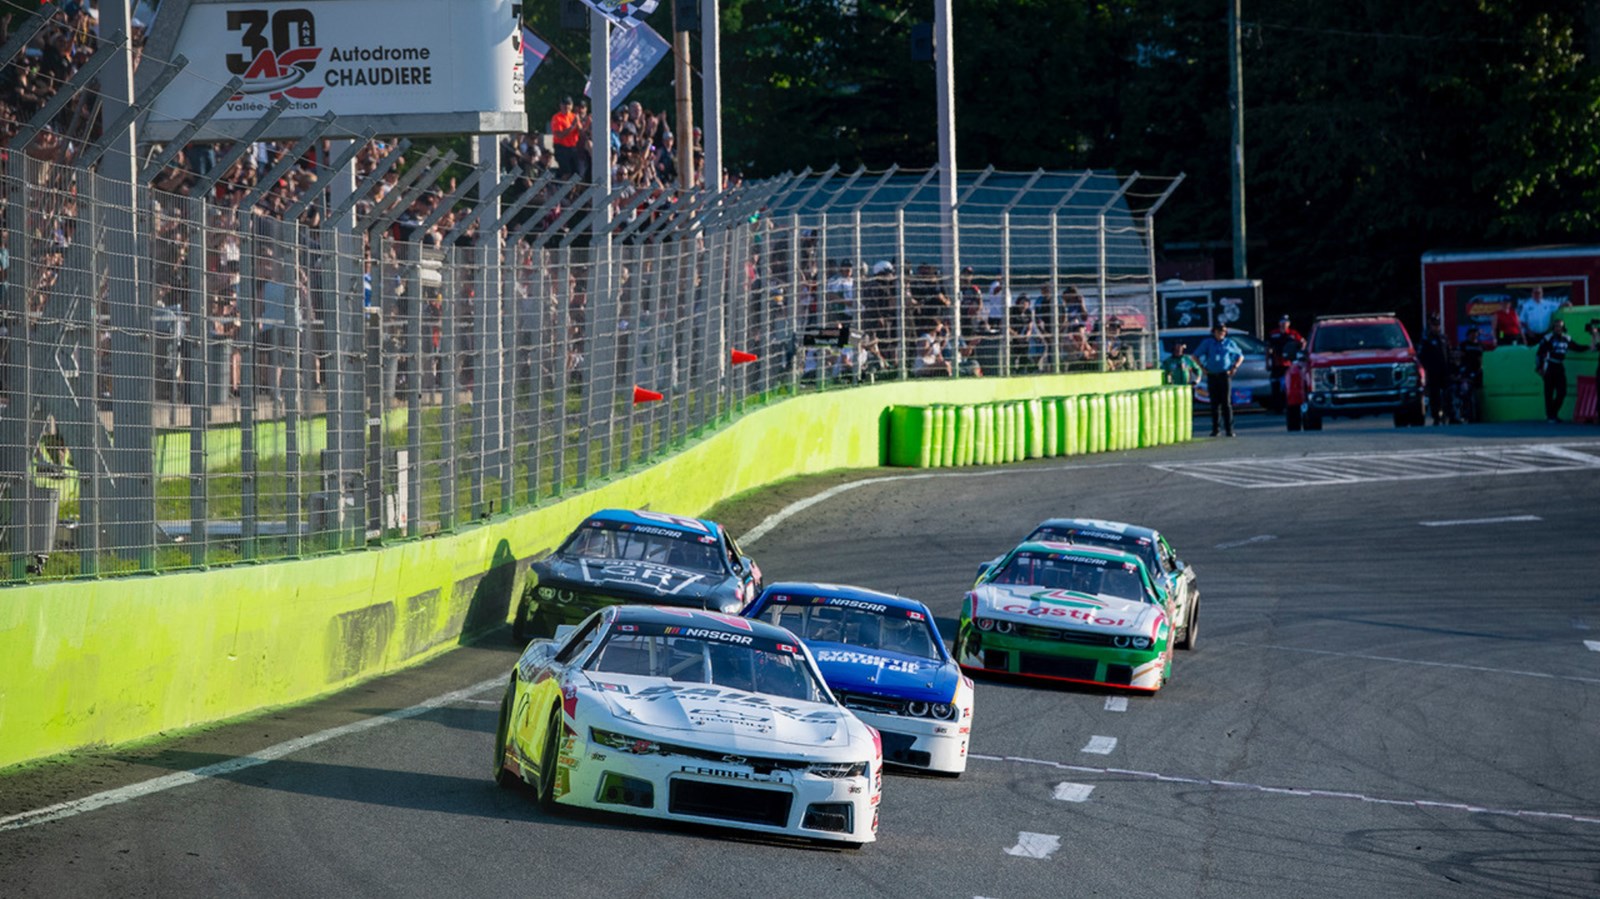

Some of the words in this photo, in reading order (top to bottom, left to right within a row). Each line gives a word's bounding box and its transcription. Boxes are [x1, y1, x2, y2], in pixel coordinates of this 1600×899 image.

[301, 20, 311, 46] ANS
[225, 8, 317, 76] 30
[329, 46, 430, 62] Autodrome
[324, 66, 432, 87] CHAUDIERE
[634, 525, 682, 539] NASCAR
[1081, 530, 1123, 541] NASCAR
[1063, 554, 1108, 567] NASCAR
[601, 565, 673, 586] GR
[830, 597, 887, 612] NASCAR
[1003, 604, 1125, 626] Castrol
[686, 628, 753, 646] NASCAR
[817, 656, 884, 669] MOTOR
